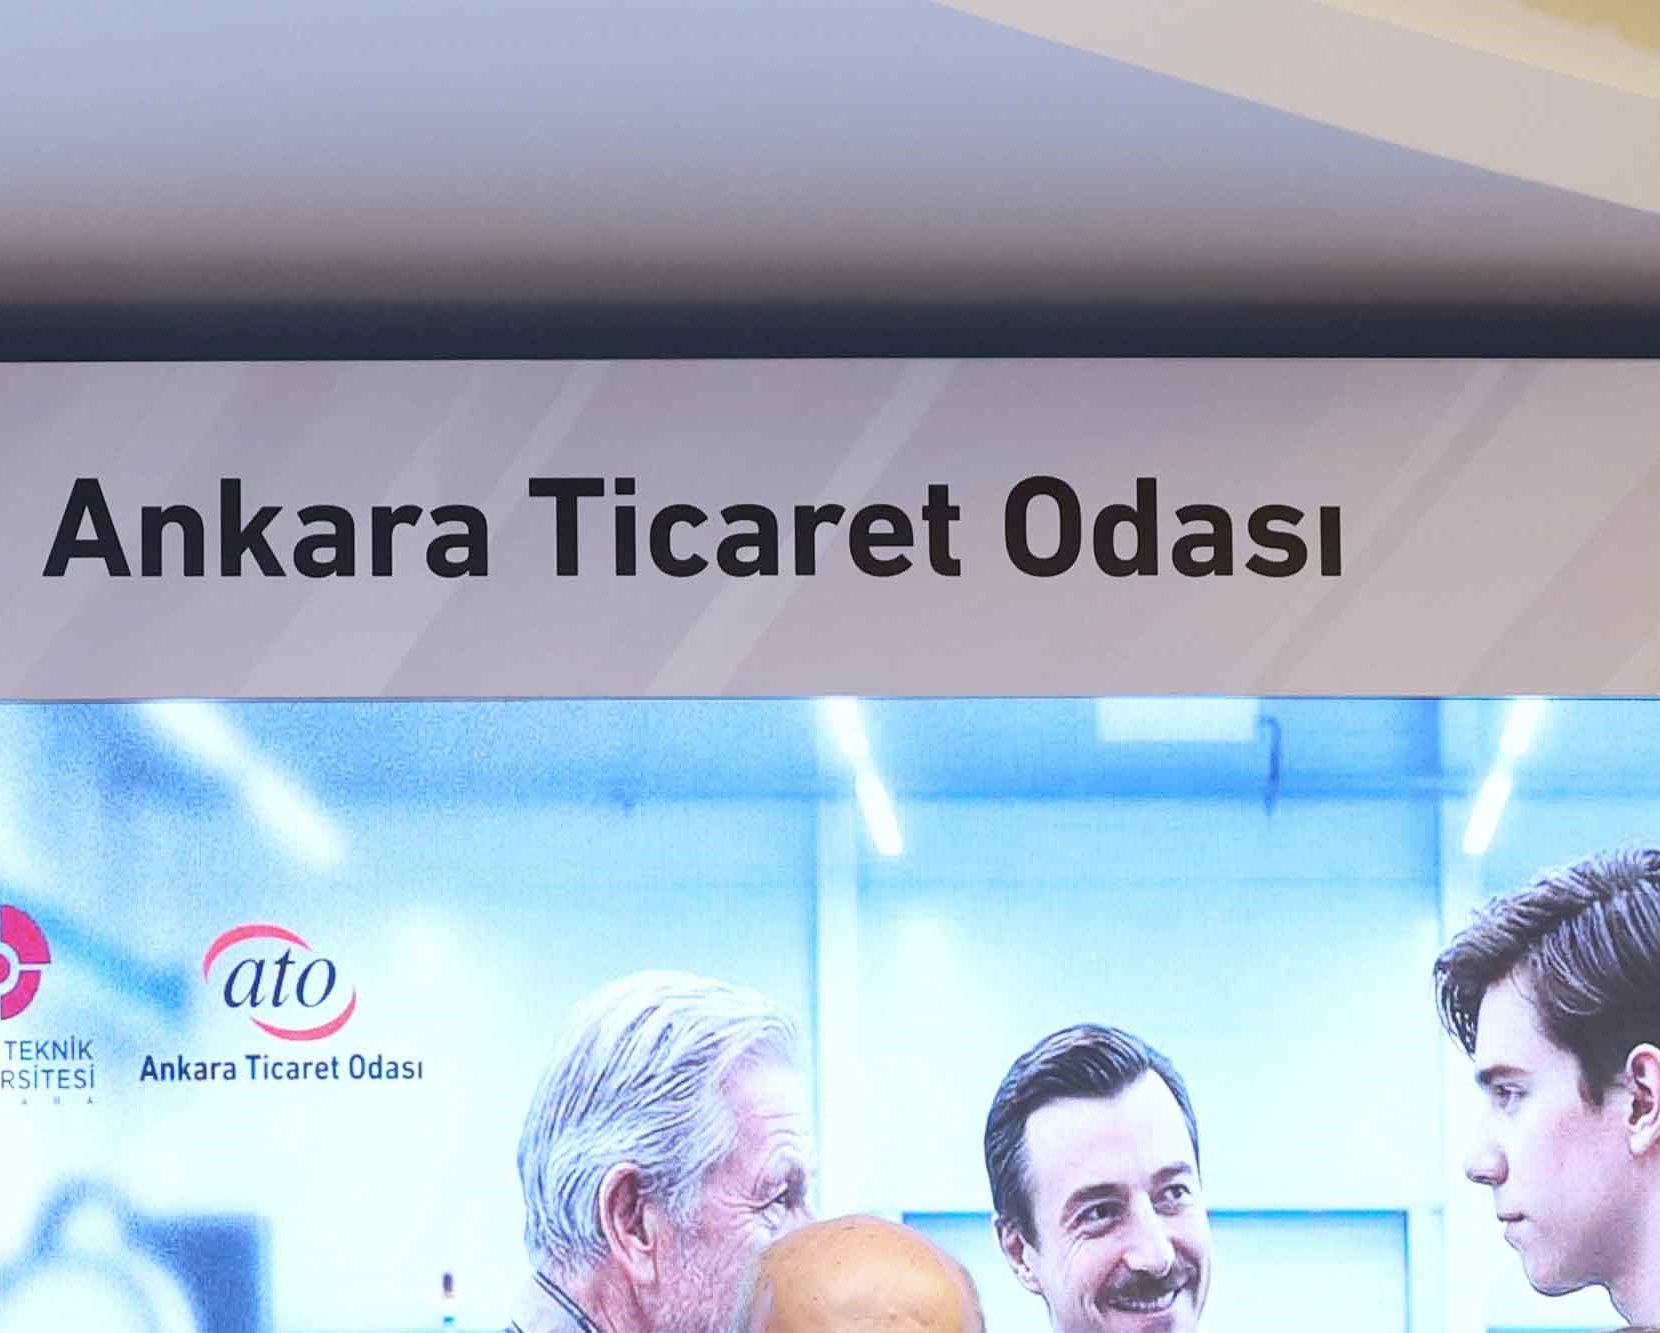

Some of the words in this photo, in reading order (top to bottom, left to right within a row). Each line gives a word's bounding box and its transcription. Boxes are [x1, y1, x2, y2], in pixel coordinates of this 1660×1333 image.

[42, 477, 491, 577] Ankara
[529, 477, 962, 577] Ticaret
[1004, 475, 1342, 578] Odası
[223, 947, 337, 1009] ato
[4, 1033, 94, 1062] TEKNİK
[140, 1055, 237, 1083] Ankara
[245, 1054, 340, 1082] Ticaret
[349, 1054, 424, 1081] Odası
